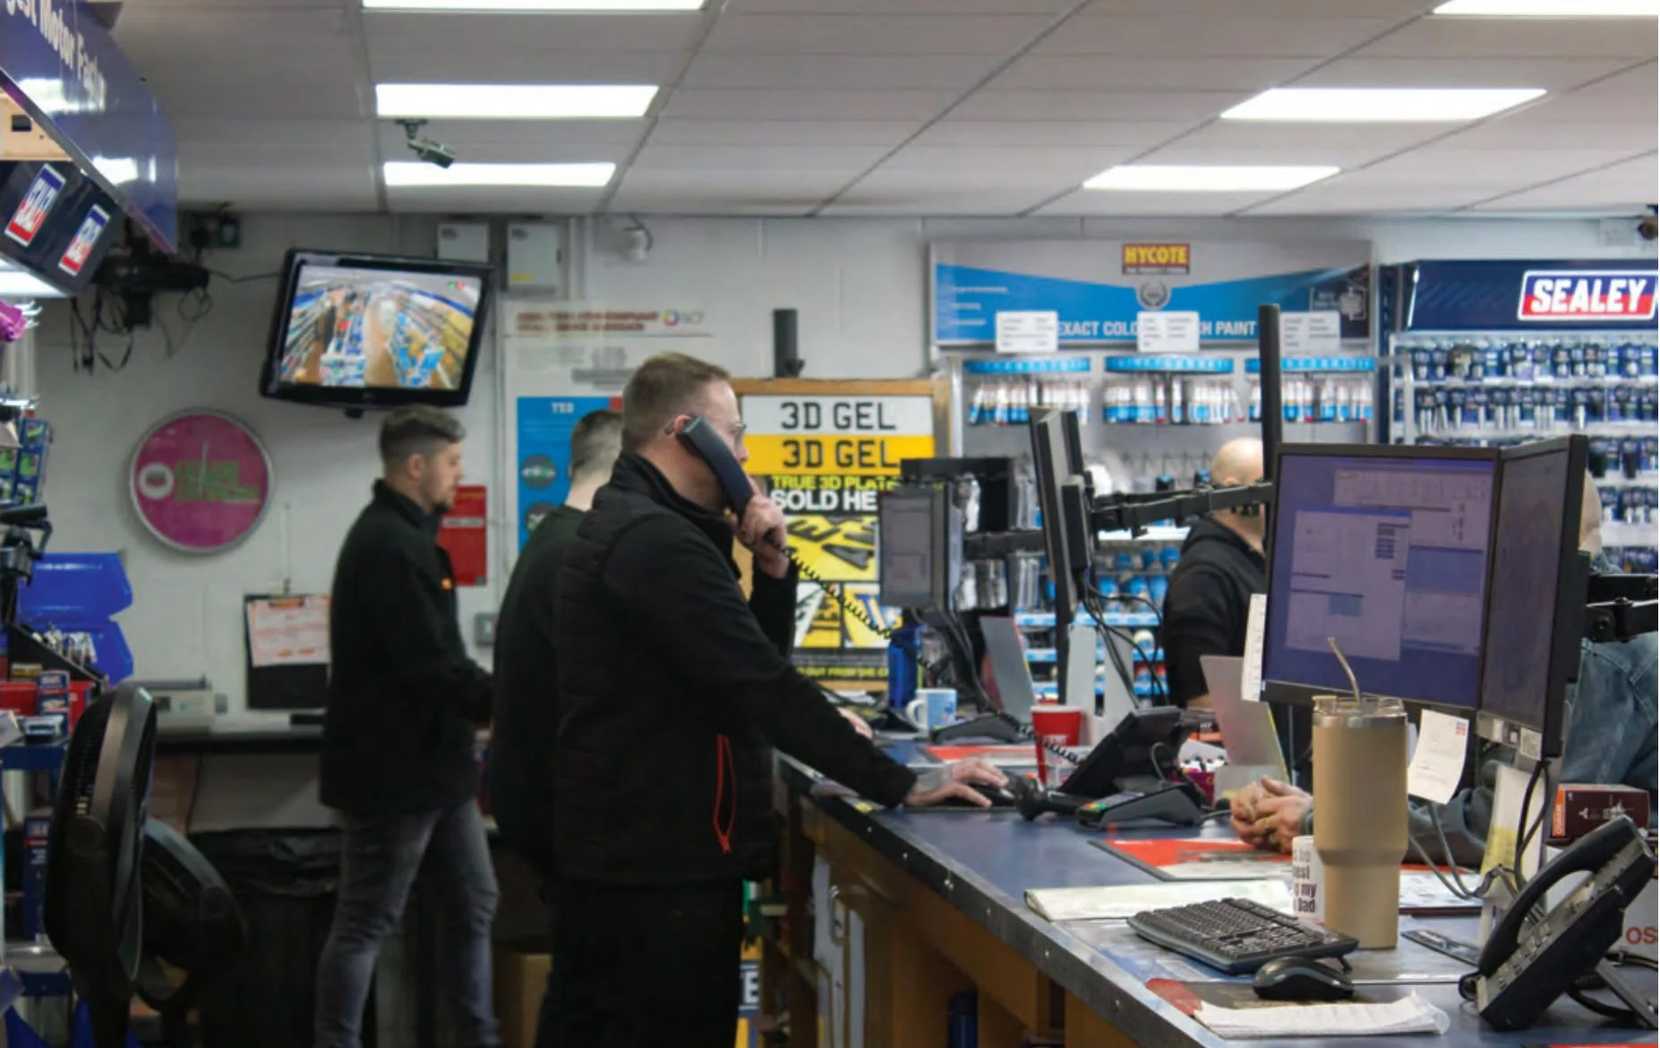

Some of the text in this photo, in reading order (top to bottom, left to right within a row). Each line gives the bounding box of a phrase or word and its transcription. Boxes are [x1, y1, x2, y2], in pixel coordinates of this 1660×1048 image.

[1125, 246, 1185, 265] HYCOTE
[1531, 278, 1647, 313] SEALEY
[1216, 320, 1256, 336] PAINT
[781, 402, 896, 430] 3D GEL
[783, 440, 899, 468] 3D GEL
[772, 475, 899, 491] TRUE 3D PLATE
[770, 489, 878, 511] SOLD HE
